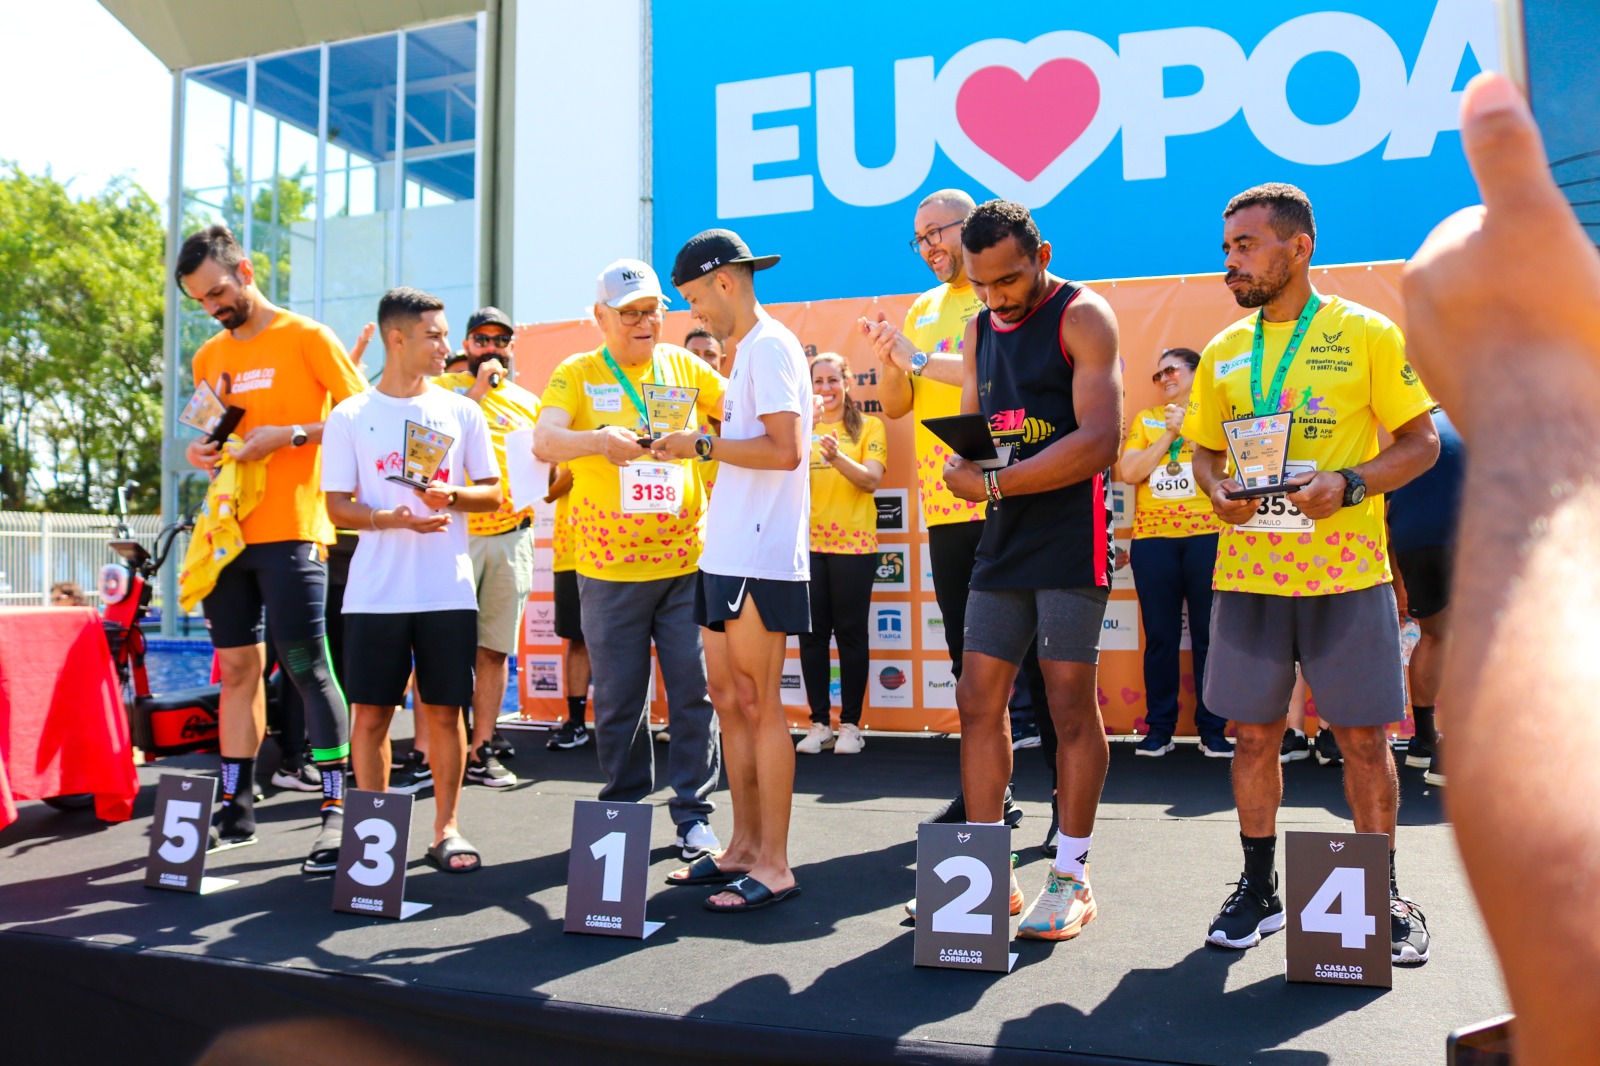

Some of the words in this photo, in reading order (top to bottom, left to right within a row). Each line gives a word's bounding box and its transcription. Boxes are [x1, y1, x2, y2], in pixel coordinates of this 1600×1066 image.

[716, 55, 935, 219] EU
[1117, 0, 1500, 182] POA
[622, 270, 646, 281] NYC
[1310, 344, 1350, 354] MOTOR'S
[1299, 416, 1337, 425] Inclusão
[1156, 478, 1189, 491] 6510
[632, 484, 676, 501] 3138
[1103, 620, 1119, 629] OU
[157, 799, 202, 864] 5
[347, 818, 397, 887] 3
[589, 831, 627, 902] 1
[932, 855, 993, 935] 2
[1300, 866, 1376, 949] 4
[585, 920, 622, 929] CORREDOR
[939, 956, 983, 964] CORREDOR
[1324, 964, 1347, 972] CASA
[1349, 965, 1363, 973] DO
[1315, 971, 1363, 980] CORREDOR
